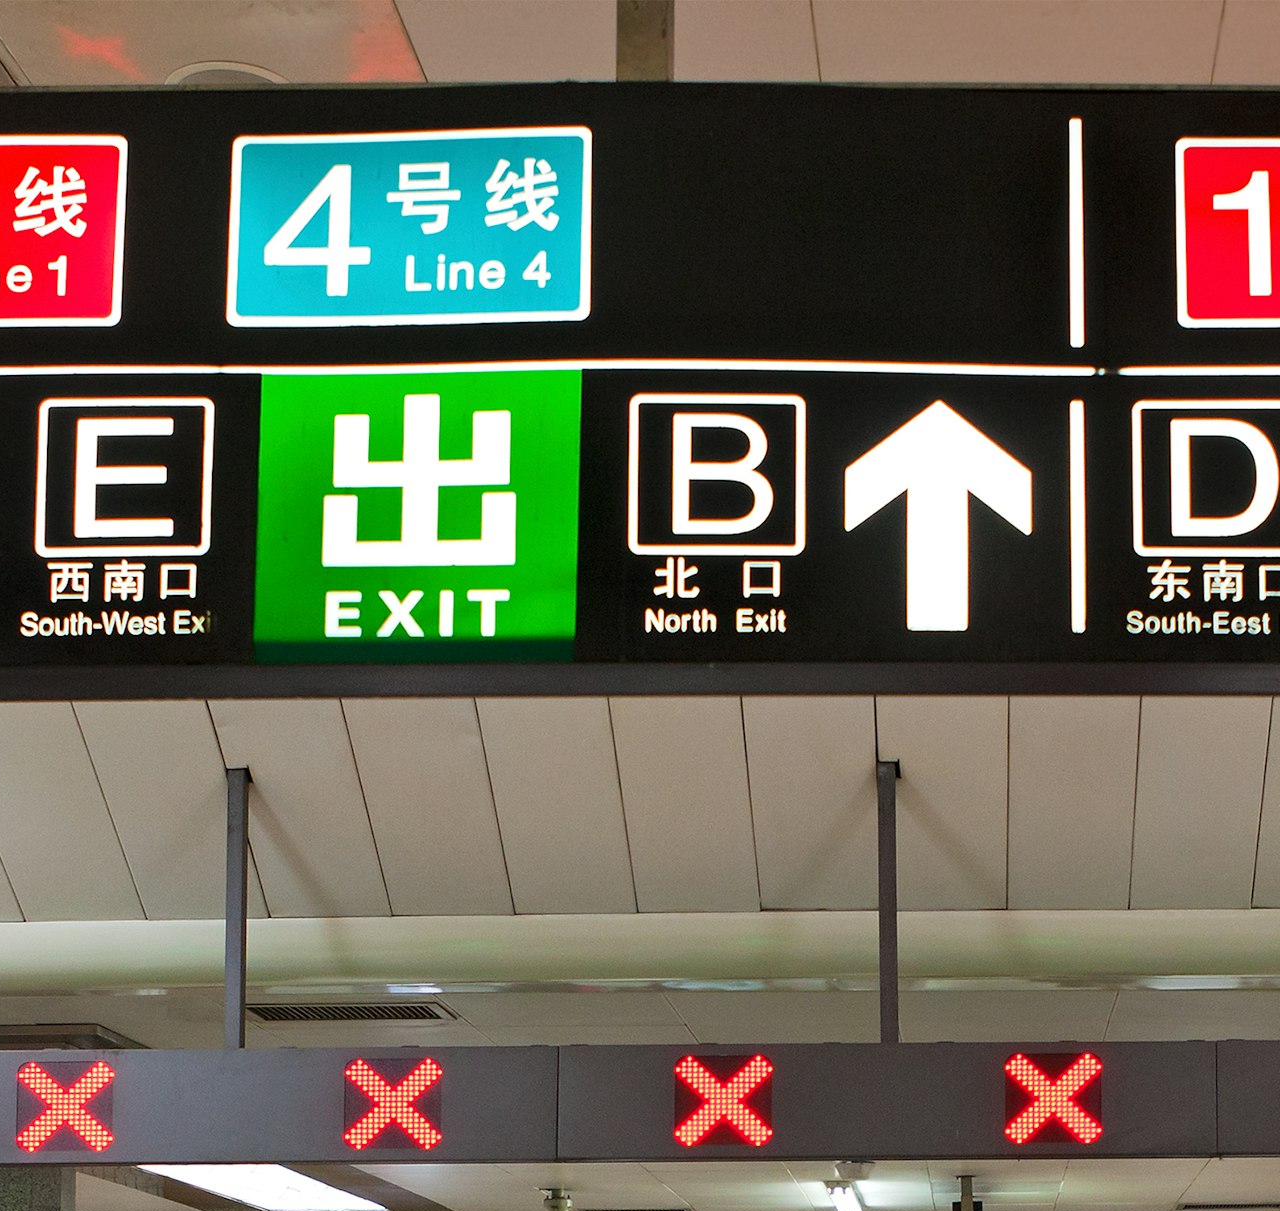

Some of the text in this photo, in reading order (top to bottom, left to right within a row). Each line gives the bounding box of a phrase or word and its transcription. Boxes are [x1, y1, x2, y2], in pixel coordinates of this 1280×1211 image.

[263, 158, 560, 297] 4 号线
[1213, 170, 1272, 297] 1
[48, 255, 68, 296] 1
[405, 250, 552, 292] Line 4
[74, 418, 175, 538] E
[322, 395, 517, 567] 出
[672, 414, 774, 535] B
[1170, 419, 1280, 537] D
[47, 563, 198, 604] 西南口
[653, 556, 781, 600] 北口
[20, 610, 167, 638] South-West
[325, 590, 511, 638] EXIT
[644, 608, 787, 634] North Exit
